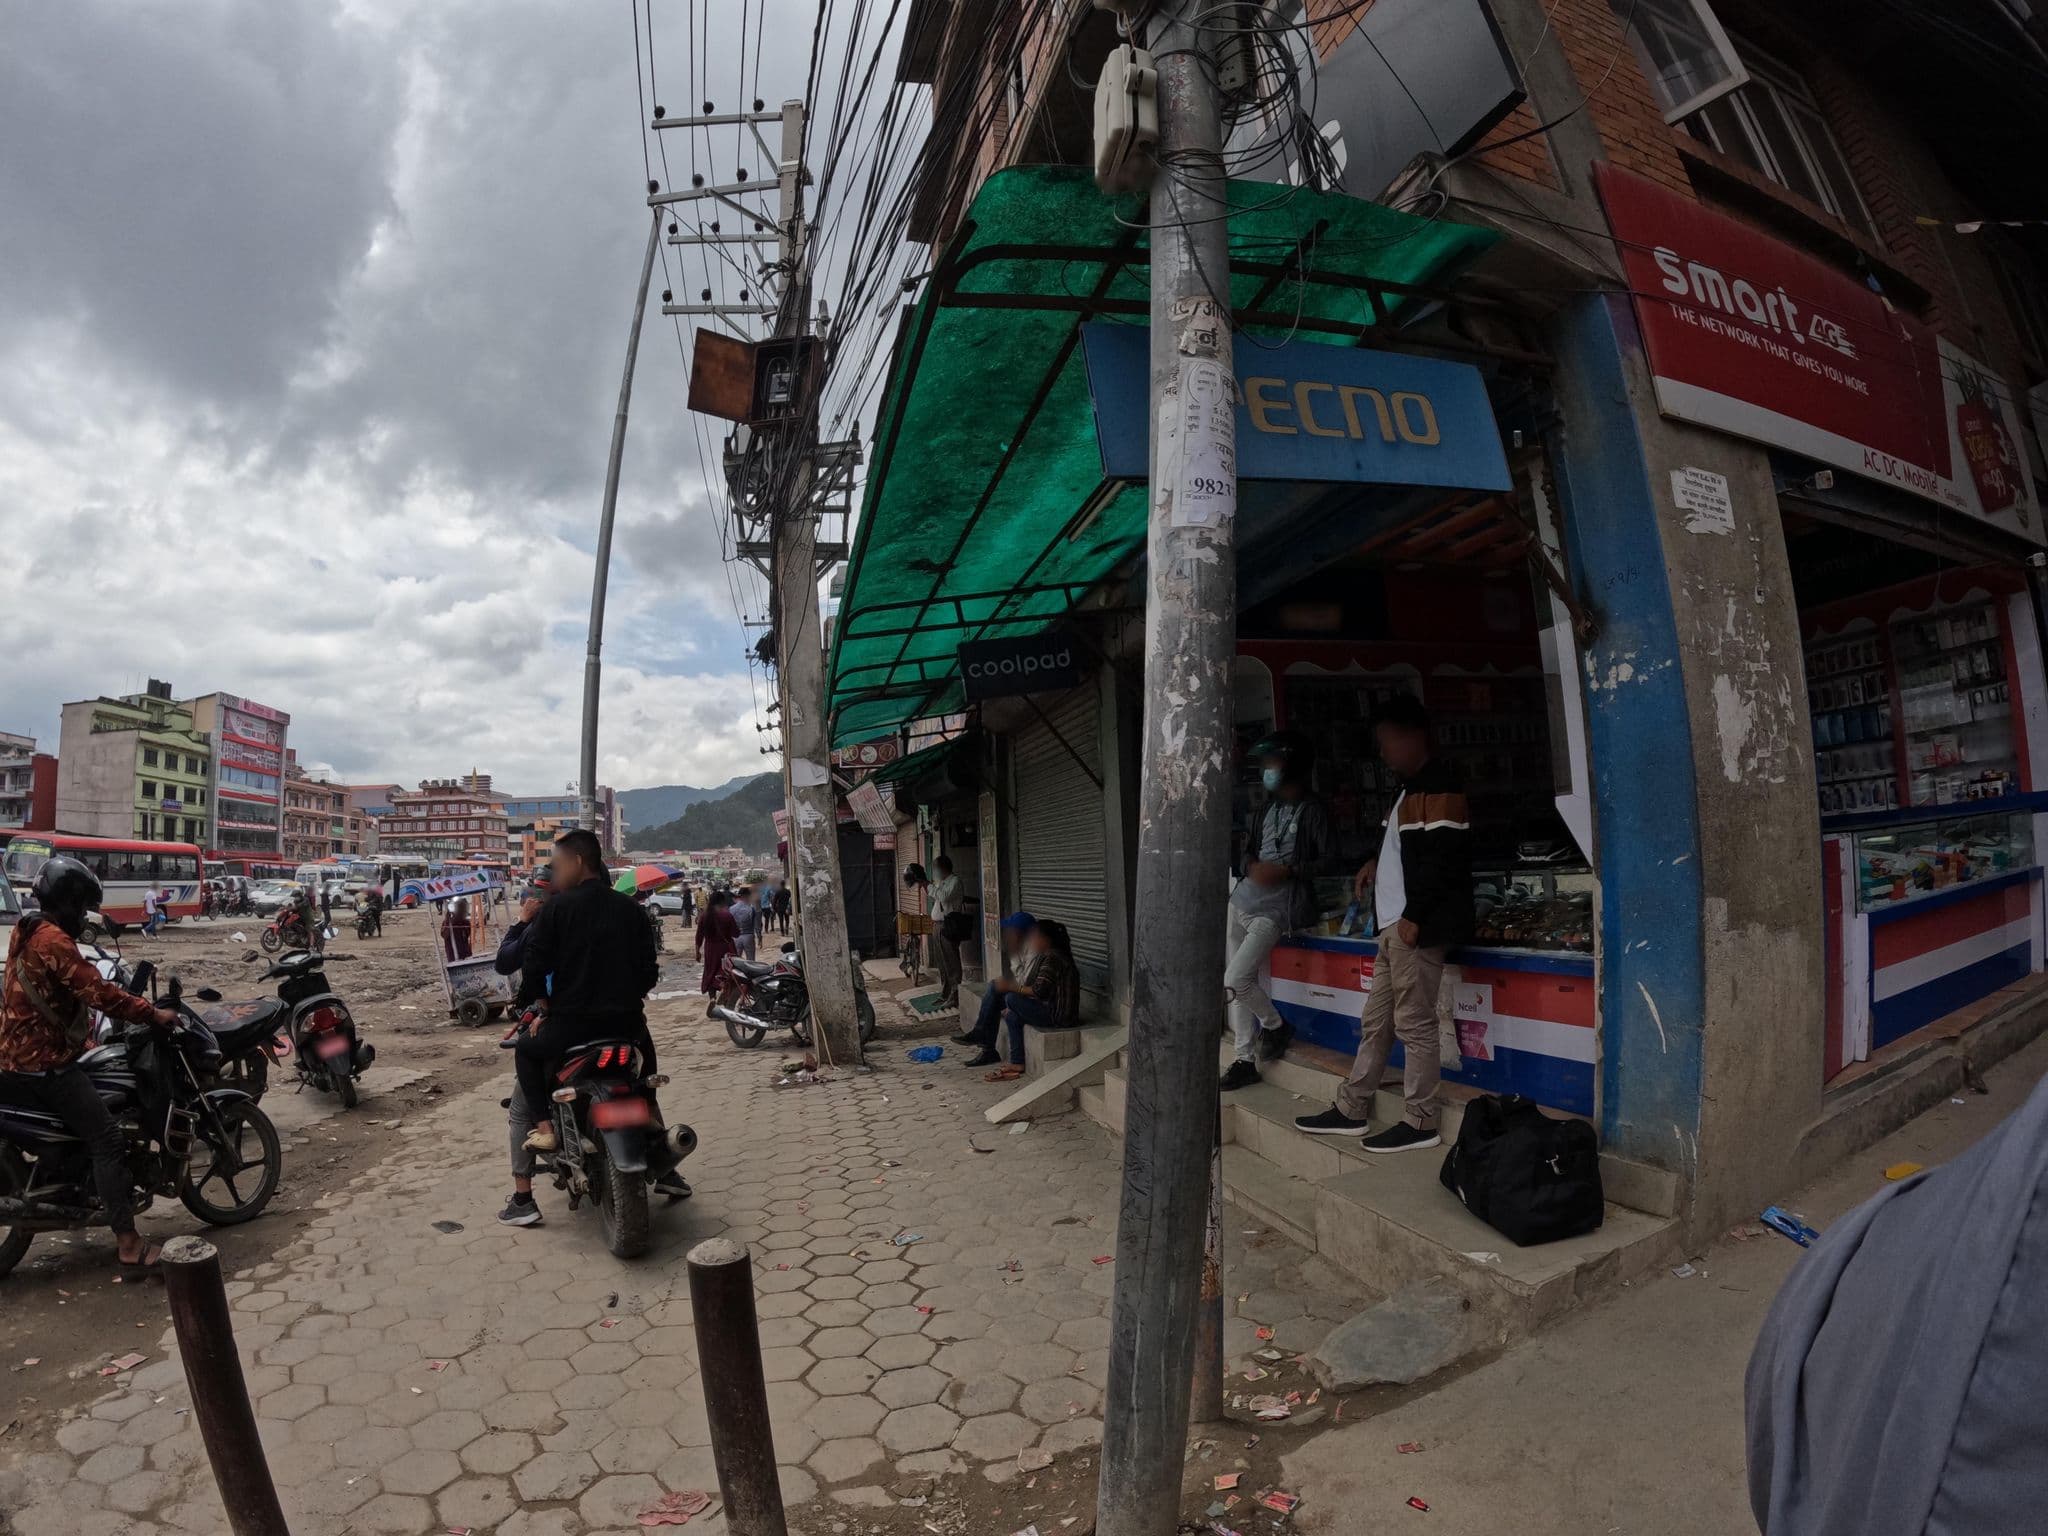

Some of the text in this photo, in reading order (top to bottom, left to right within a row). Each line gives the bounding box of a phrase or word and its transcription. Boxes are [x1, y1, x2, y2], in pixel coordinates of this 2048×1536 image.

[1669, 302, 1869, 396] THE NETWORK THAT GIVES YOU MORE
[1243, 376, 1441, 447] ECNO
[1863, 448, 1940, 495] AC DC Mobile
[967, 647, 1071, 677] coolpad
[1458, 1001, 1477, 1013] Ncell
